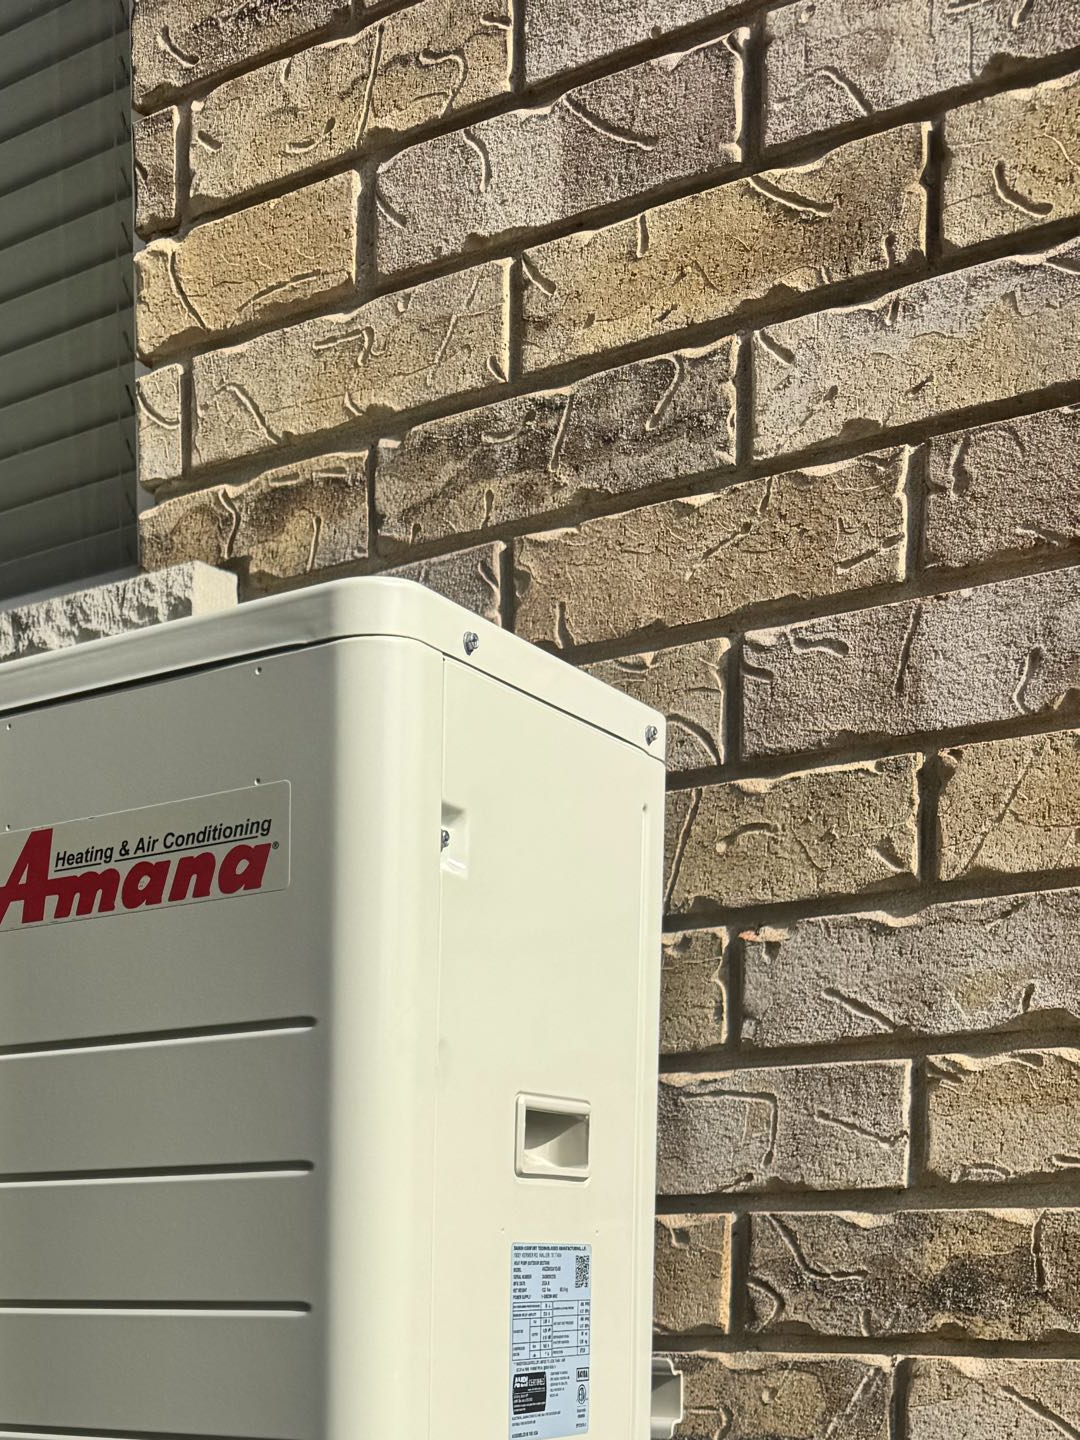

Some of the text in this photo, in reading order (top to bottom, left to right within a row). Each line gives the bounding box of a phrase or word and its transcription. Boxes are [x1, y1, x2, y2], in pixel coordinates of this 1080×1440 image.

[54, 818, 272, 868] Heating & Air Conditioning
